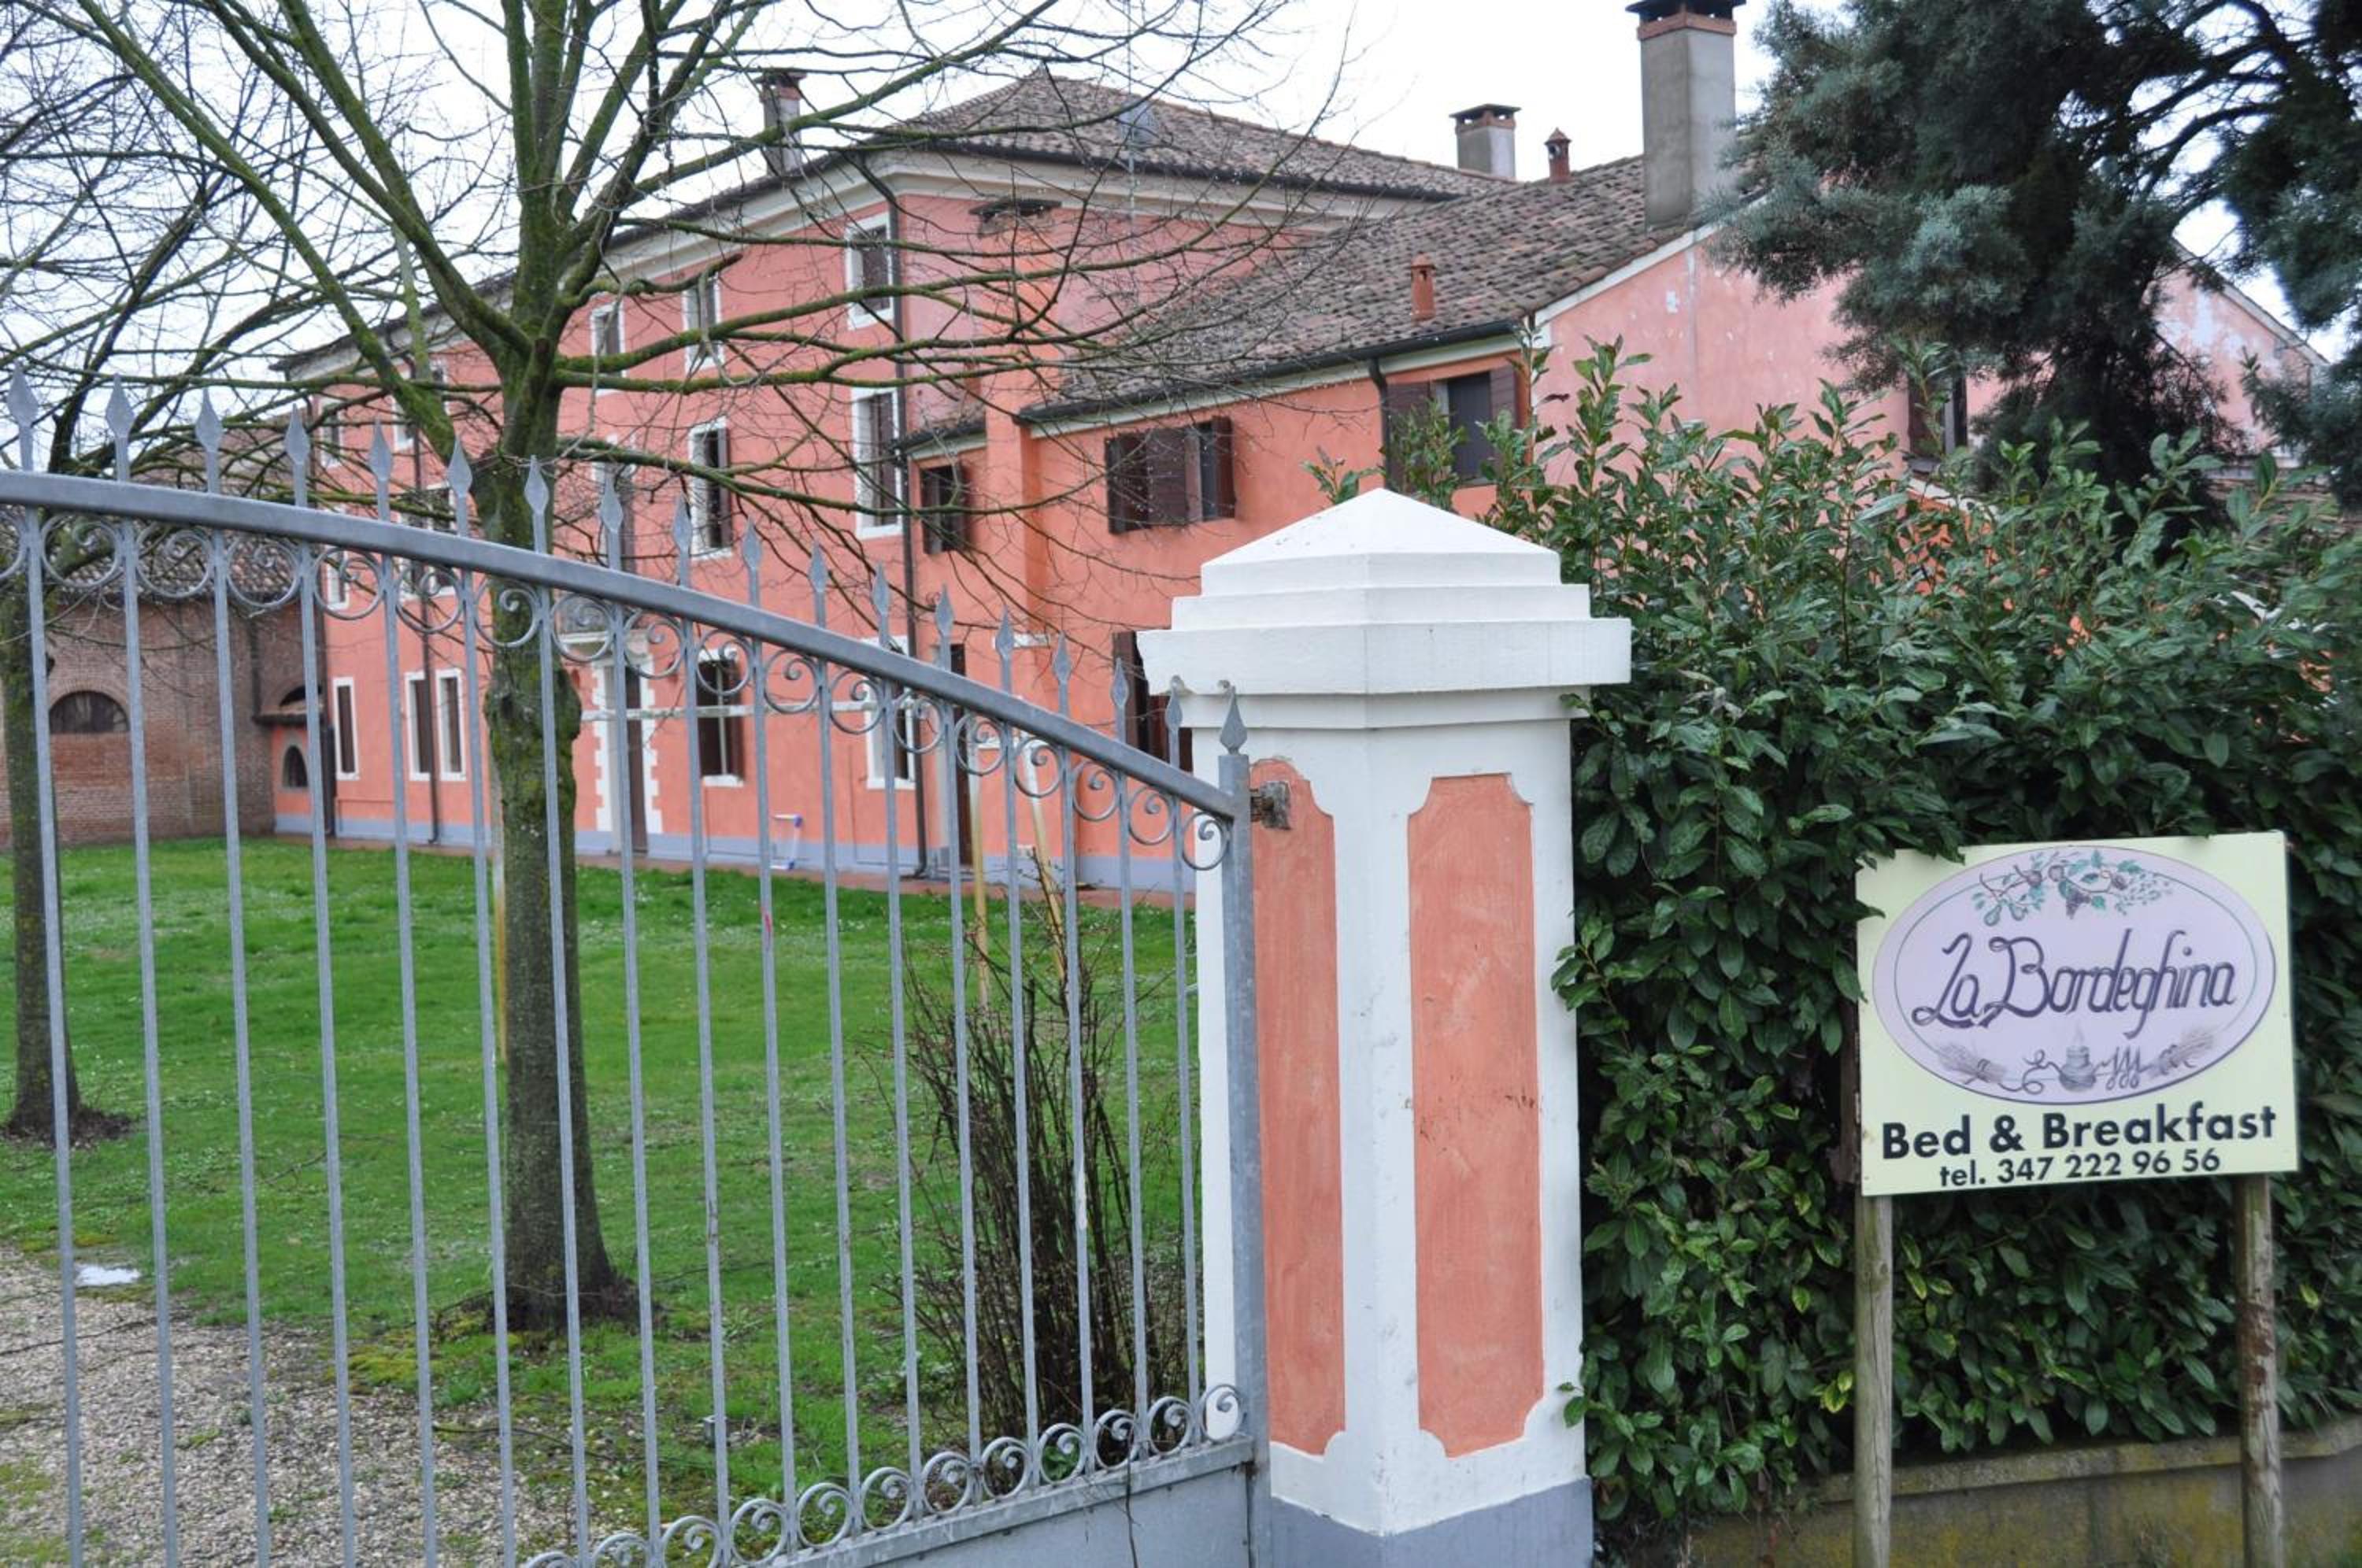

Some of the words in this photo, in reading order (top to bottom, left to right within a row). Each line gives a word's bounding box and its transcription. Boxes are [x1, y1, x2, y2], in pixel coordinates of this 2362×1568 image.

[1912, 933, 1979, 1029] La
[1980, 928, 2237, 1039] Bordeghina
[1883, 1115, 1970, 1159] Bed
[1989, 1115, 2024, 1153] &
[2043, 1101, 2276, 1149] Breakfast
[1940, 1160, 1986, 1187] tel.
[1997, 1156, 2053, 1183] 347
[2065, 1152, 2121, 1178] 222
[2132, 1150, 2171, 1174] 96
[2182, 1148, 2220, 1172] 56
